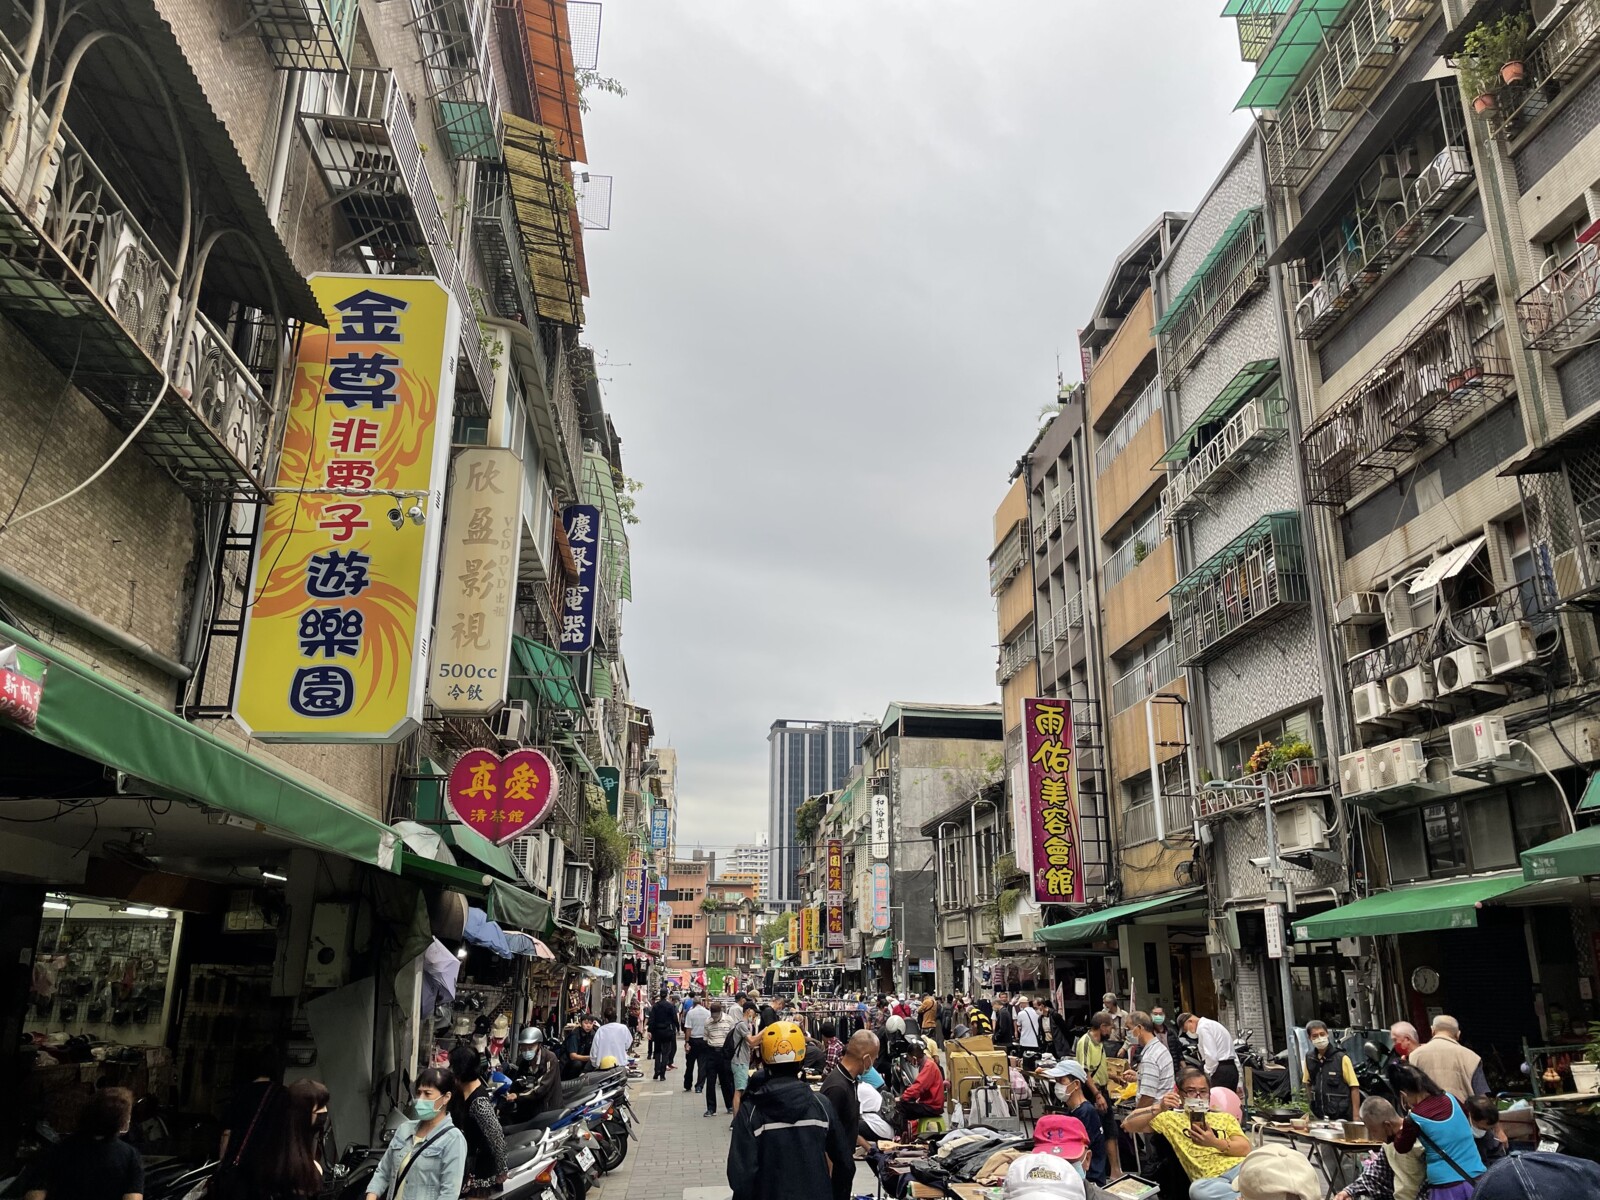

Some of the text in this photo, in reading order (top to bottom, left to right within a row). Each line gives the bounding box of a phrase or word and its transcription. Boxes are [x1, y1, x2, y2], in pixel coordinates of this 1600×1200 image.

[288, 288, 410, 718] 金尊非電子遊樂園
[501, 516, 515, 551] VCD
[450, 460, 505, 651] 欣盈影視
[497, 555, 511, 589] DVD
[439, 663, 498, 679] 500cc
[447, 684, 485, 702] 冷飲
[458, 760, 540, 801] 真愛
[1031, 703, 1074, 896] 雨佑美容會館
[470, 809, 526, 823] 清茶館
[875, 798, 886, 841] 和裕實業
